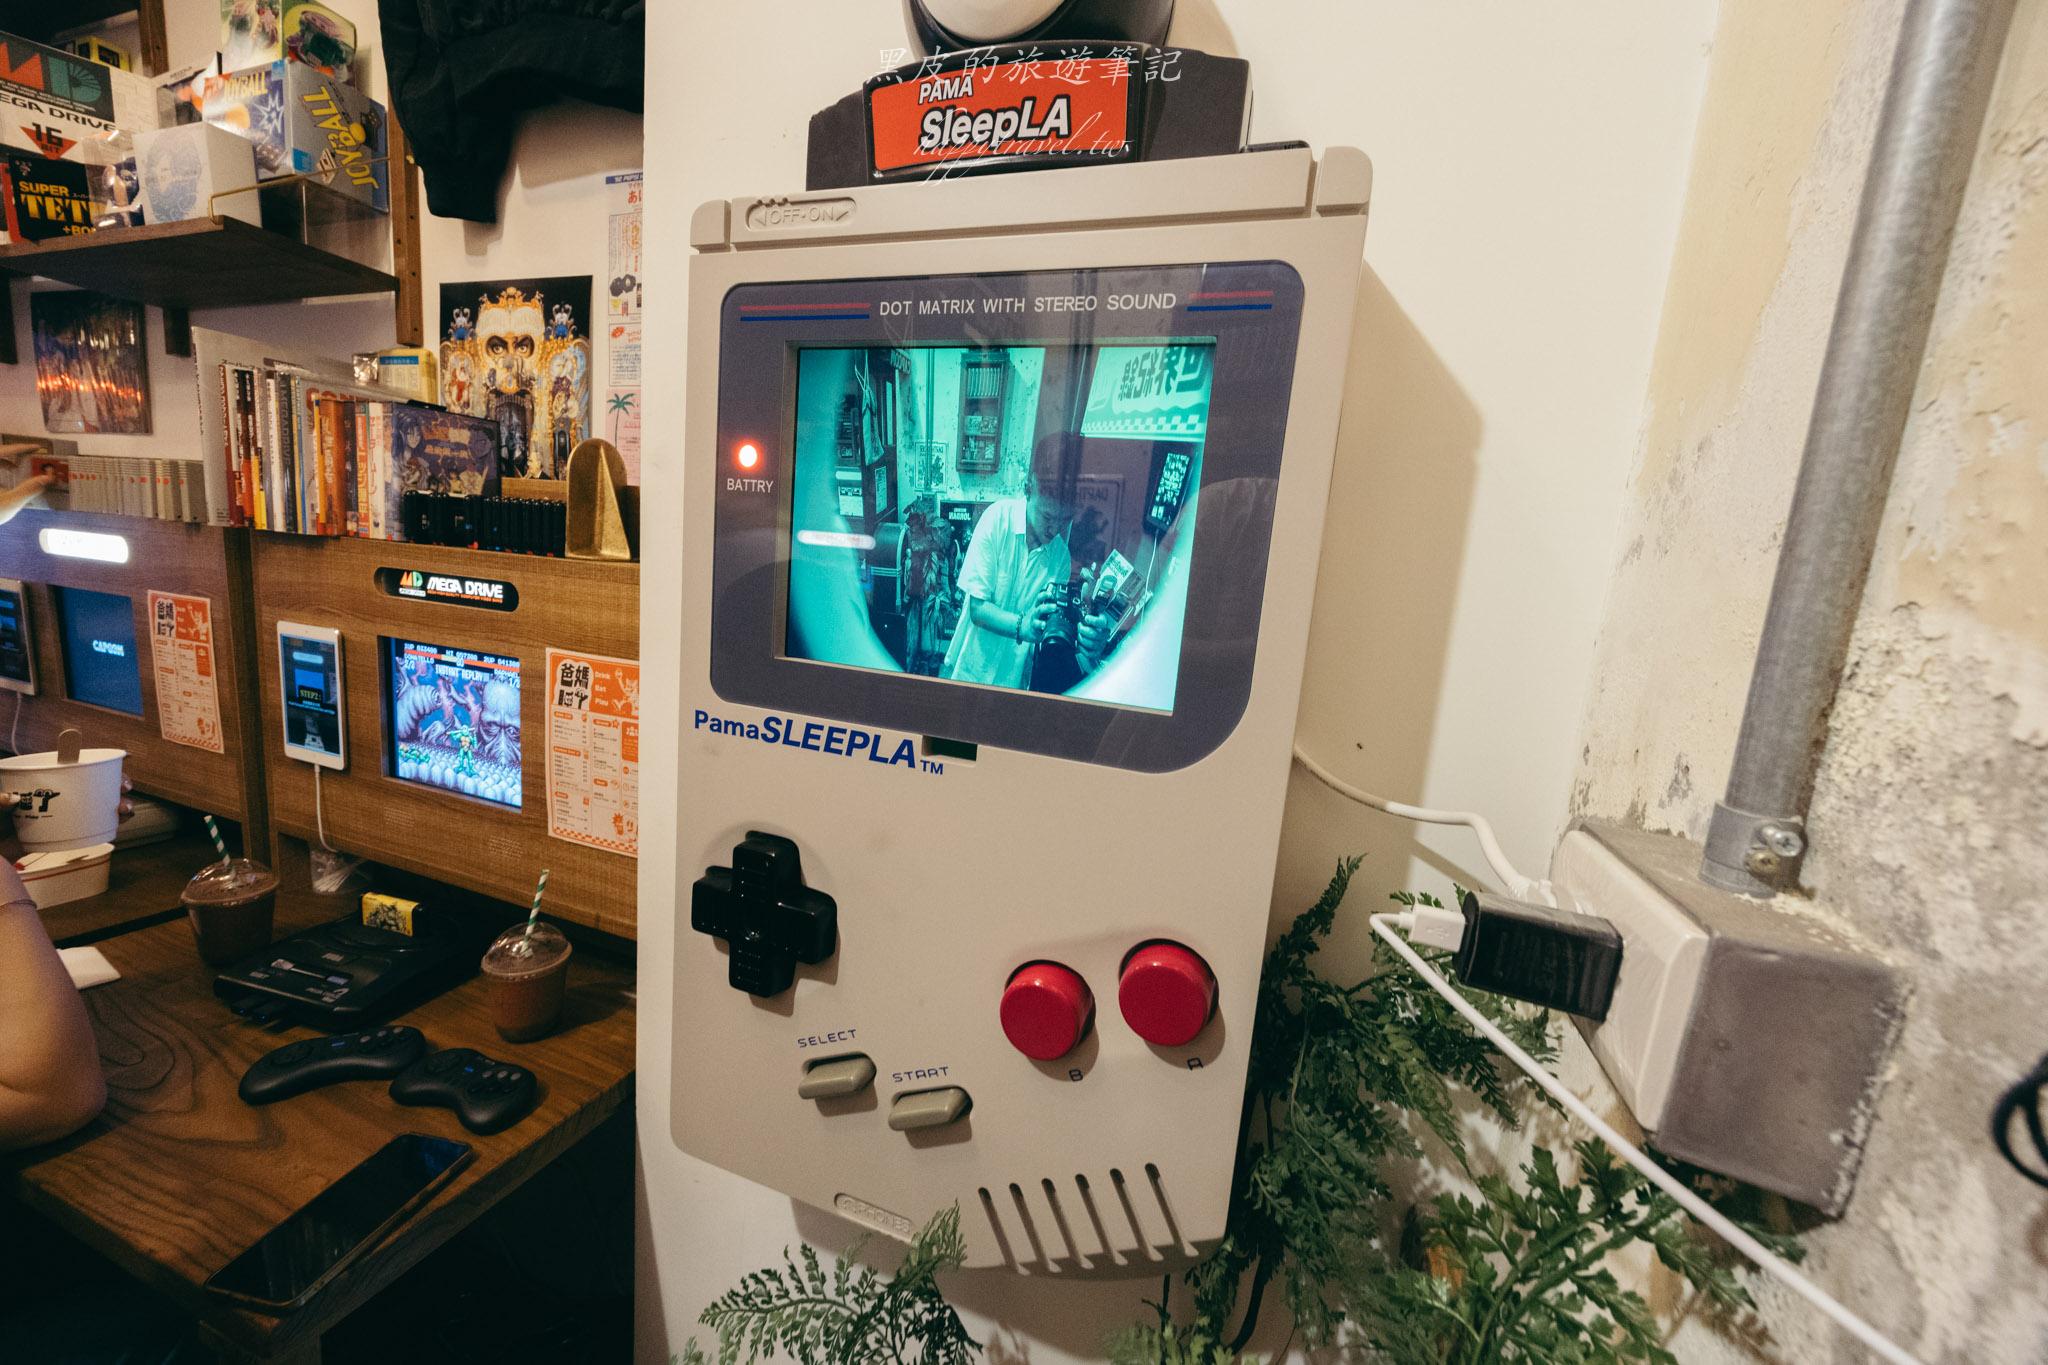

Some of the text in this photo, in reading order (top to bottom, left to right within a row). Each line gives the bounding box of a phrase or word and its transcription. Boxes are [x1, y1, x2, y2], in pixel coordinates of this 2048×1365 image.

[918, 76, 975, 105] PAMA
[49, 107, 117, 132] DRIVE
[920, 94, 1072, 149] SleepLA
[31, 122, 63, 147] 16
[19, 181, 69, 198] SUPER
[880, 293, 1177, 316] DOT MATRIX WITH STEREO SOUND
[727, 478, 773, 493] BATTRY
[427, 577, 463, 594] MEGA
[465, 581, 503, 598] DRIVE
[92, 639, 125, 657] CAPCOM
[560, 663, 590, 690] 爸媽
[694, 709, 944, 775] PamaSLEEPLA TM
[797, 1029, 857, 1048] SELECT
[892, 1066, 949, 1083] START
[1187, 1057, 1203, 1071] A
[1069, 1069, 1083, 1082] B
